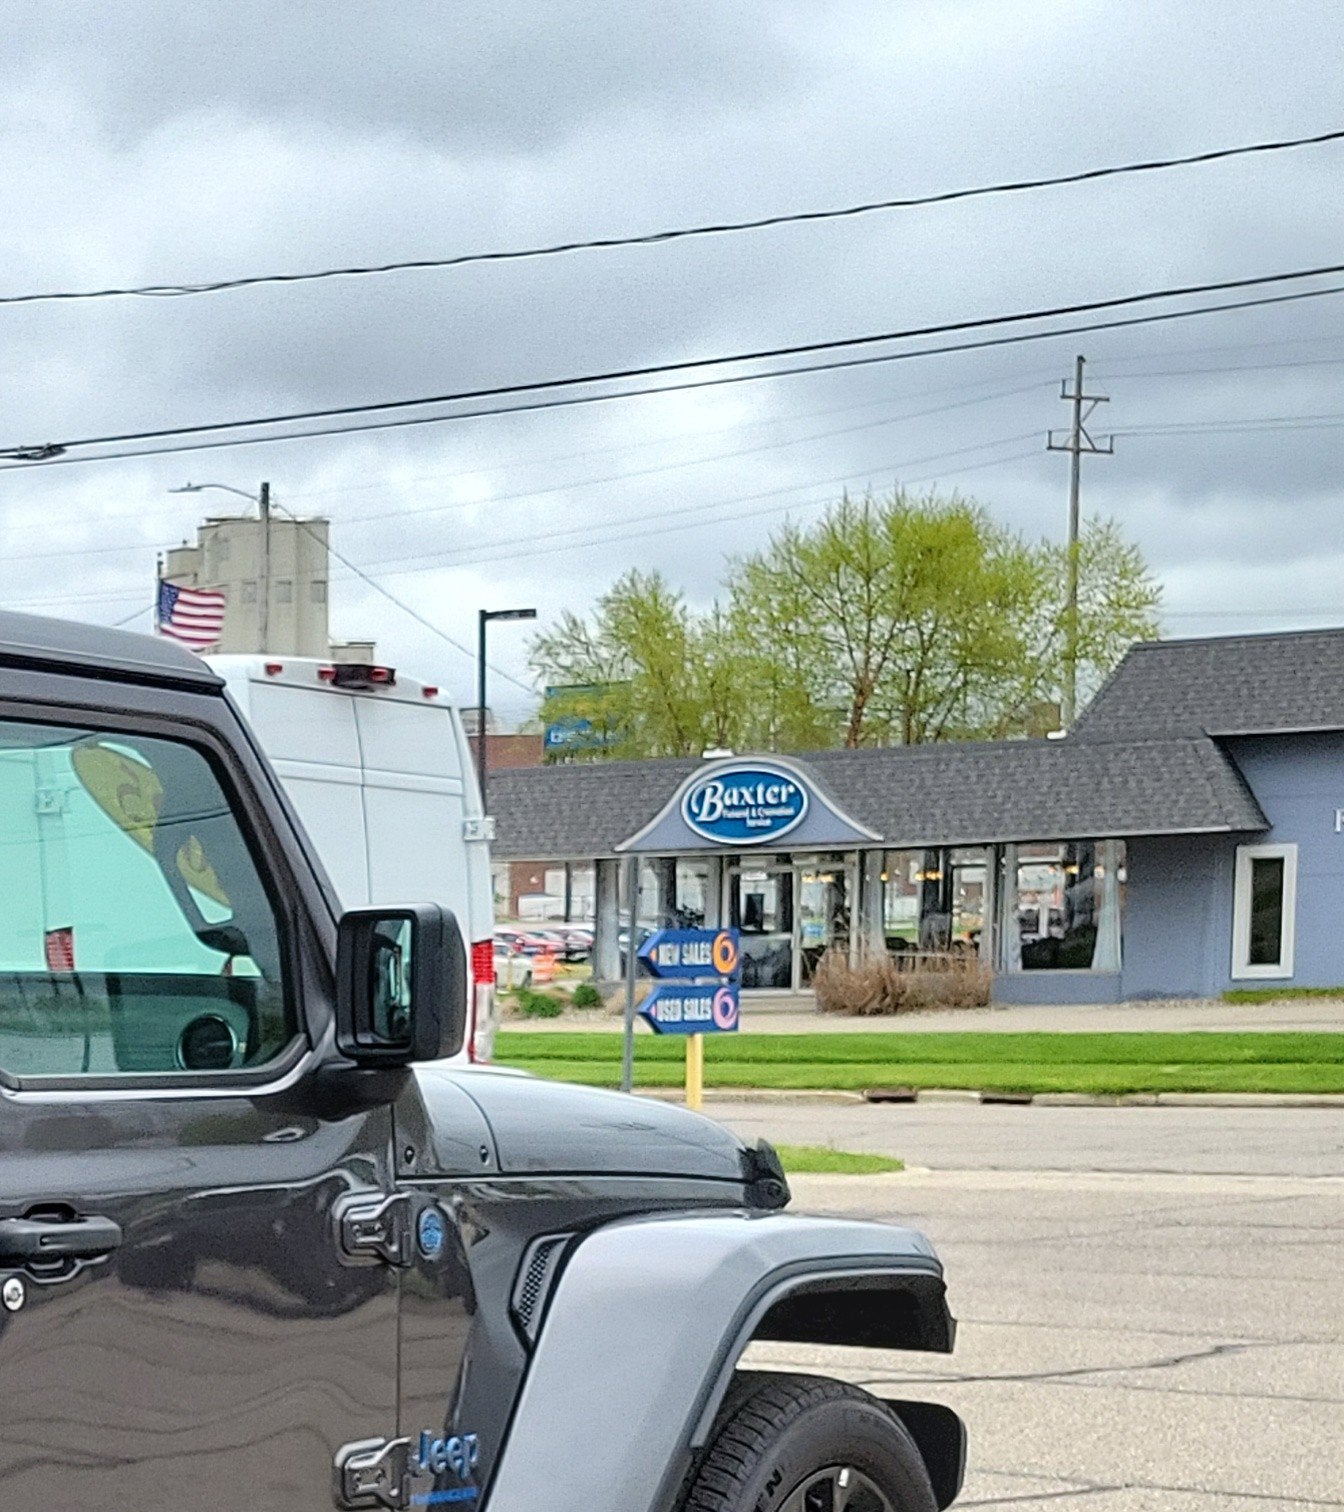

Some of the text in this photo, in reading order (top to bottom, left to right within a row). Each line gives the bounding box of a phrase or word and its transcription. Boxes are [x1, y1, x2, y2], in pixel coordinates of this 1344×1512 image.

[690, 779, 796, 821] Baxter
[657, 942, 681, 966] NEW
[682, 942, 712, 966] SALES
[656, 998, 682, 1022] USED
[683, 997, 712, 1021] SALES
[411, 1429, 478, 1479] Jeep
